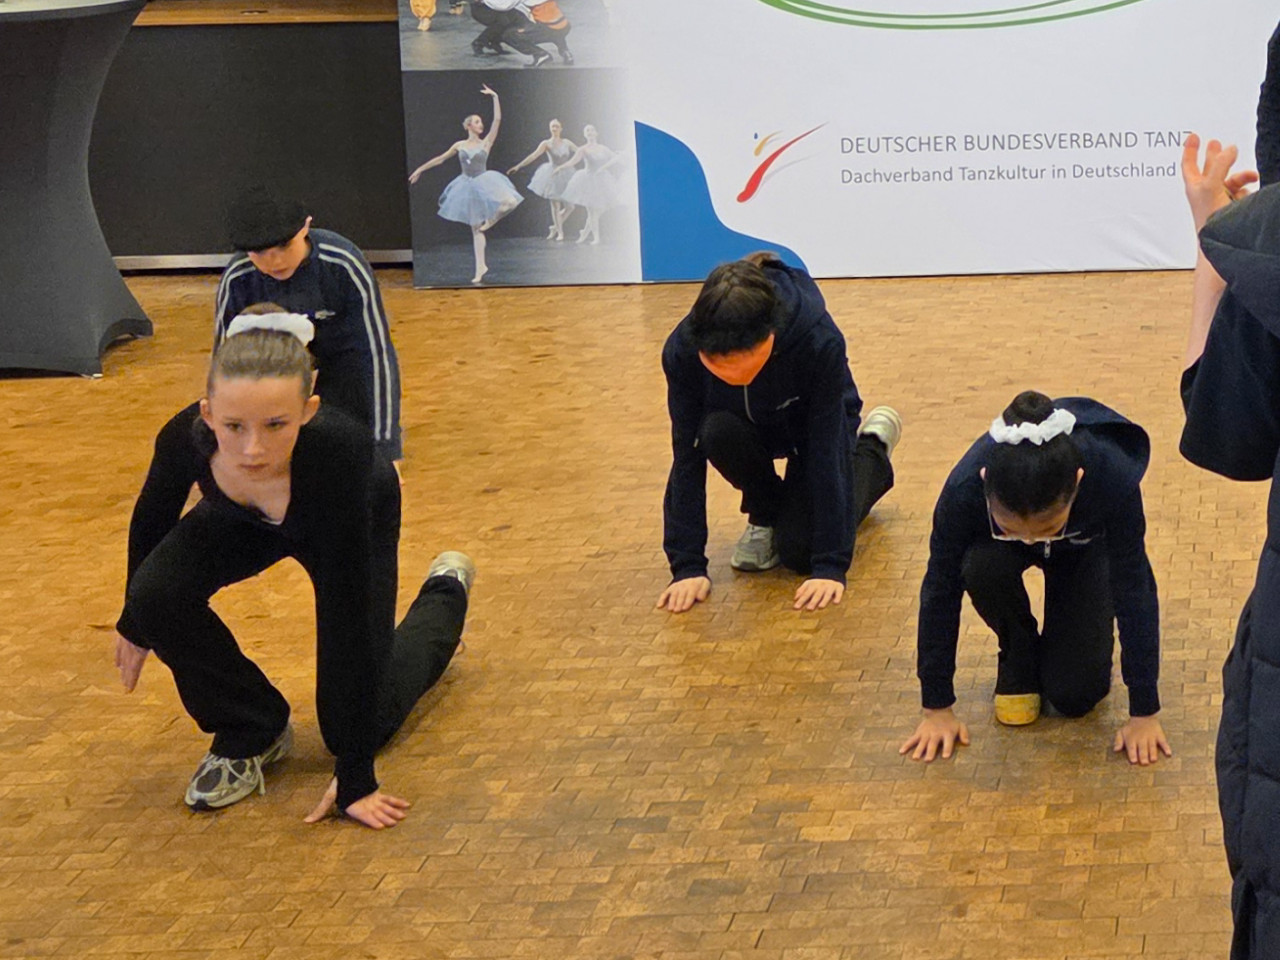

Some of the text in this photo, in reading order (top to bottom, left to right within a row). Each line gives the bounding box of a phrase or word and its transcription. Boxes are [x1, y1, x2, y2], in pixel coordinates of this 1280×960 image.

[840, 135, 957, 154] DEUTSCHER
[964, 131, 1138, 151] BUNDESVERBAND
[841, 161, 1177, 184] Dachverband Tanzkultur in Deutschland
